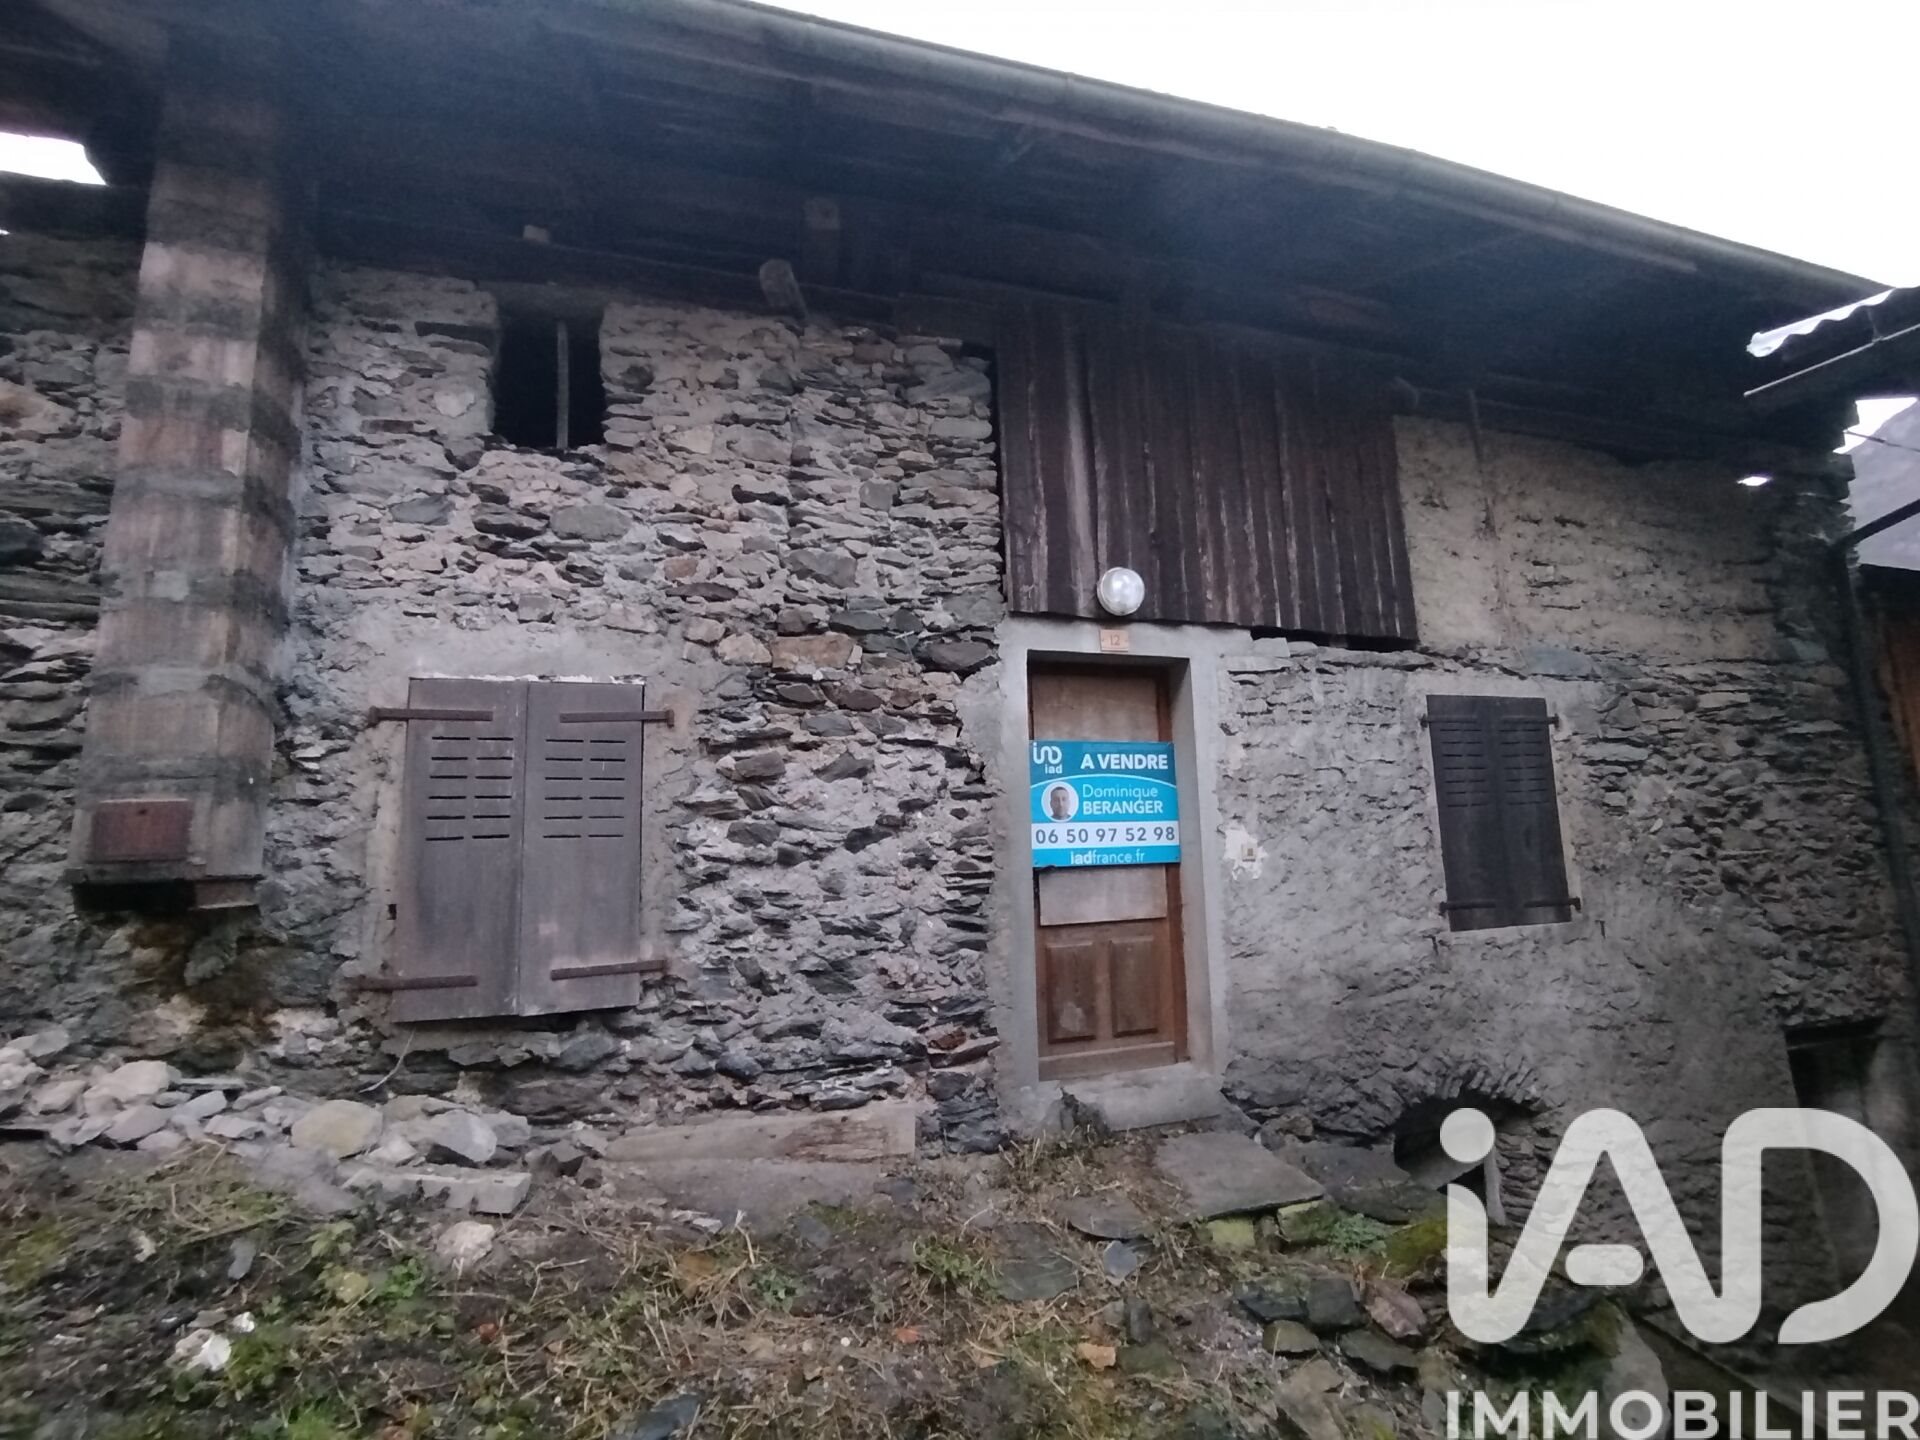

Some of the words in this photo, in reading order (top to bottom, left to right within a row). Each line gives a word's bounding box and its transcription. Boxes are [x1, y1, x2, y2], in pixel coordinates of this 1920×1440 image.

[1110, 634, 1121, 647] 12
[1044, 764, 1063, 775] iad
[1080, 753, 1095, 770] A
[1097, 753, 1169, 770] VENDRE
[1082, 784, 1159, 801] Dominique
[1082, 801, 1164, 816] BERANGER
[1035, 829, 1059, 844] 06
[1066, 828, 1089, 844] 50
[1095, 828, 1118, 842] 97
[1125, 827, 1147, 842] 52
[1153, 826, 1175, 841] 98
[1070, 848, 1146, 865] iadfrance.fr
